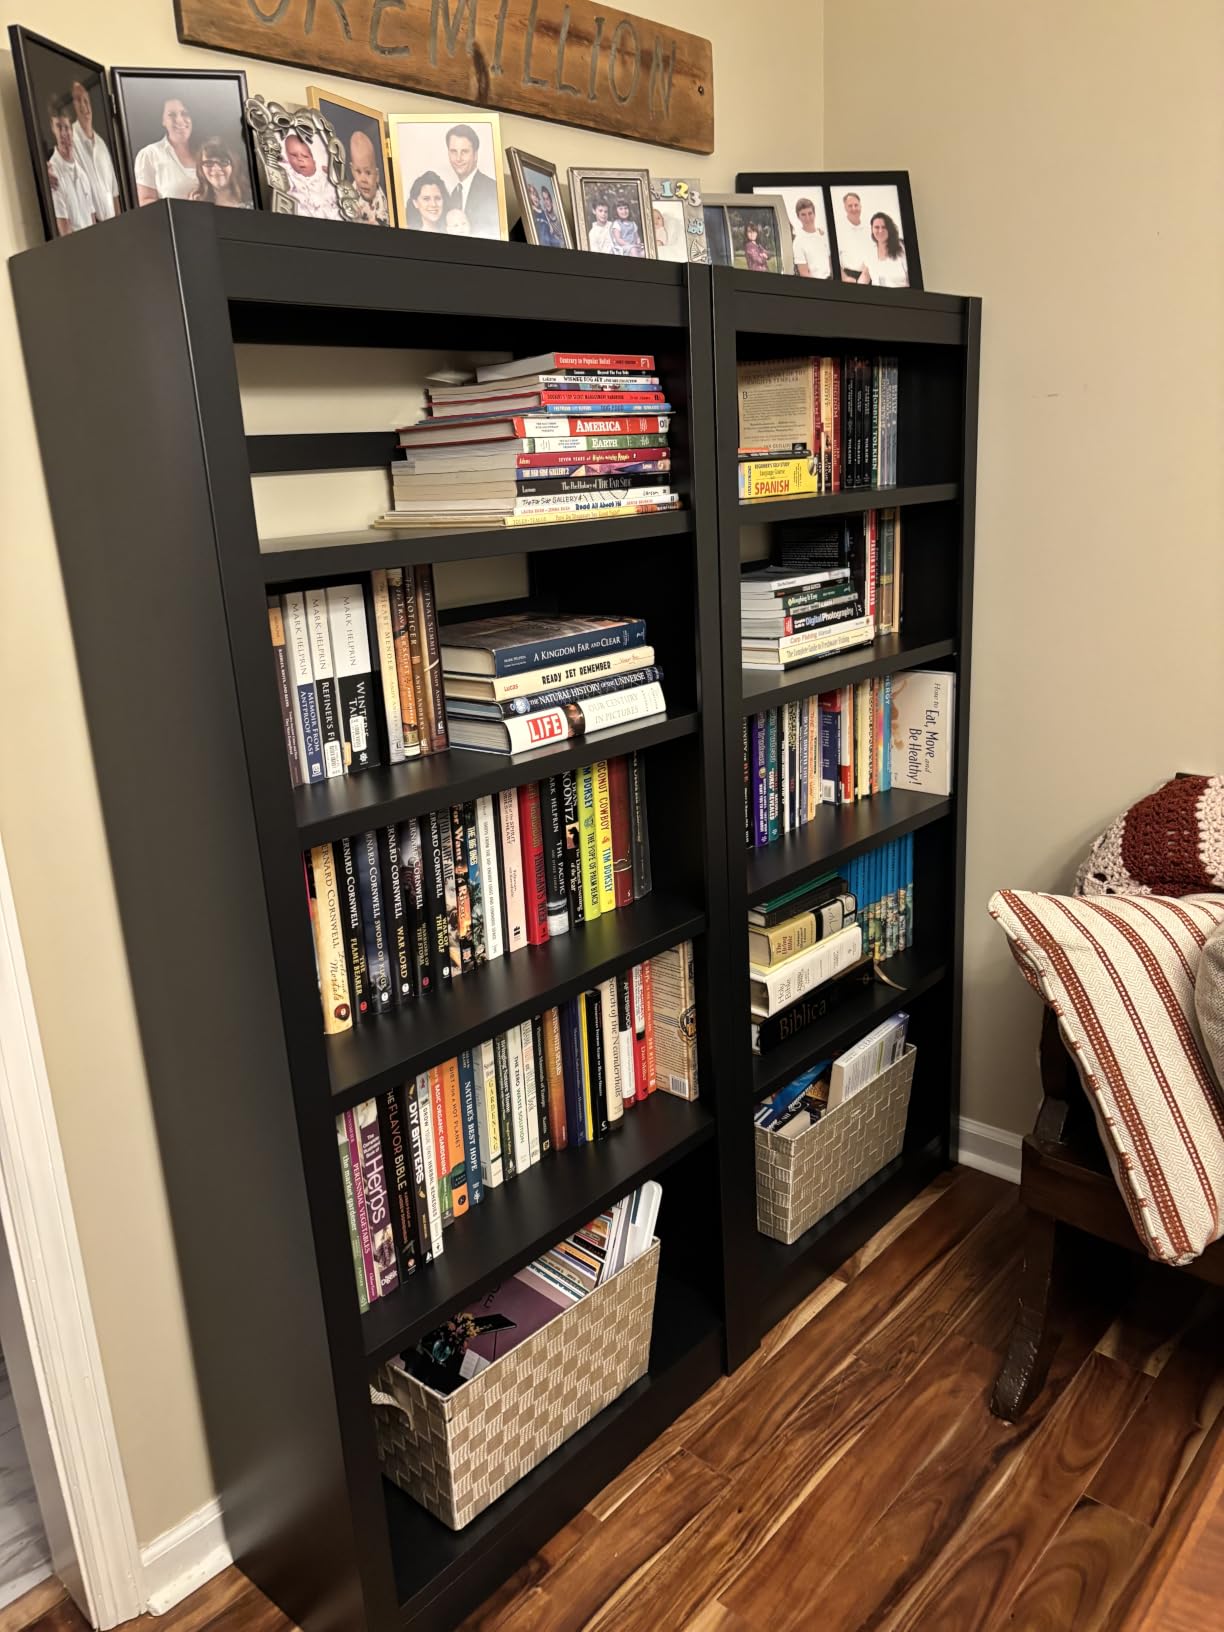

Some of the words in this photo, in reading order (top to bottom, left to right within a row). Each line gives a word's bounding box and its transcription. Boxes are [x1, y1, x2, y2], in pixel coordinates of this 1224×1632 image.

[661, 181, 674, 198] 1
[675, 182, 688, 200] 2
[689, 190, 702, 207] 3
[575, 418, 621, 432] AMERICA
[592, 436, 618, 448] EARTH
[598, 478, 609, 488] THE
[609, 477, 619, 487] FAR
[619, 476, 632, 487] SIDE
[754, 480, 790, 495] SPANISH
[574, 502, 590, 510] Read
[291, 602, 302, 634] MARK
[311, 598, 322, 630] MARK
[340, 595, 353, 626] MARK
[380, 597, 389, 625] HEART
[803, 613, 823, 627] Digital
[821, 605, 854, 622] Photography
[345, 628, 358, 666] HELPRIN
[532, 651, 539, 661] A
[539, 644, 575, 660] KINGDOM
[576, 641, 590, 653] FAR
[589, 639, 601, 650] AND
[599, 635, 621, 648] CLEAR
[801, 631, 817, 641] Fishing
[295, 636, 307, 675] HELPRIN
[315, 631, 327, 670] HELPRIN
[383, 631, 394, 671] MENDER
[541, 671, 563, 685] READY
[578, 660, 612, 677] REMEMBER
[300, 690, 312, 734] ANTPROOF
[307, 691, 317, 726] MEMOIR
[417, 697, 425, 730] ANDREWS
[588, 700, 605, 713] OUR
[605, 692, 639, 709] CENTURY
[527, 714, 563, 741] LIFE
[924, 710, 939, 727] Eat,
[305, 735, 314, 756] CASE
[311, 728, 320, 751] FROM
[909, 728, 922, 741] Be
[926, 731, 939, 758] Move
[907, 743, 922, 785] Healthy!
[596, 761, 607, 794] OCONUT
[561, 772, 574, 822] KOONTZ
[582, 778, 593, 809] DORSEY
[598, 797, 609, 831] COWBOY
[467, 826, 476, 838] THE
[468, 838, 477, 850] BIG
[586, 831, 594, 844] THE
[341, 837, 353, 875] ERNARD
[469, 850, 478, 866] ONES
[554, 840, 563, 857] THE
[587, 845, 596, 861] POPE
[602, 847, 611, 863] TIM
[533, 851, 546, 899] FINNEGAN'S
[556, 862, 566, 894] PACIFIC
[588, 862, 596, 870] OF
[589, 871, 598, 886] PALM
[603, 864, 613, 892] DORSEY
[345, 876, 358, 929] CORNWELL
[590, 887, 599, 906] BEACH
[537, 901, 548, 924] WEEK
[373, 919, 384, 949] SWORD
[395, 926, 405, 949] WAR
[437, 933, 445, 953] WOLF
[350, 938, 359, 964] FLAME
[377, 951, 386, 960] OF
[398, 951, 408, 978] LORD
[328, 961, 343, 1001] Mortals
[352, 965, 362, 995] BEARER
[606, 978, 617, 1008] Search
[784, 979, 792, 1000] Bible
[608, 1008, 617, 1017] of
[622, 982, 631, 1029] AFTERSHOCK
[609, 1020, 618, 1035] the
[780, 999, 827, 1040] Biblica
[497, 1038, 508, 1069] Bringing
[609, 1036, 622, 1097] Neanderthals
[500, 1069, 511, 1092] Nature
[513, 1069, 521, 1086] ZERO
[433, 1084, 441, 1103] BASIC
[462, 1081, 474, 1122] NATURE'S
[503, 1092, 513, 1113] Home
[515, 1087, 523, 1110] WASTE
[407, 1101, 419, 1125] DIY
[435, 1104, 444, 1134] ORGANIC
[386, 1104, 403, 1154] FLAVOR
[467, 1123, 477, 1145] BEST
[517, 1110, 526, 1143] SOLUTION
[340, 1153, 350, 1169] the
[410, 1126, 425, 1184] BITTERS
[438, 1136, 447, 1174] GARDENING
[469, 1147, 479, 1171] HOPE
[343, 1171, 354, 1197] market
[351, 1162, 364, 1207] PERENNIAL
[393, 1154, 408, 1190] BIBLE
[363, 1155, 392, 1224] Herbs
[347, 1198, 359, 1231] gardener
[357, 1207, 370, 1254] VEGETABLES
